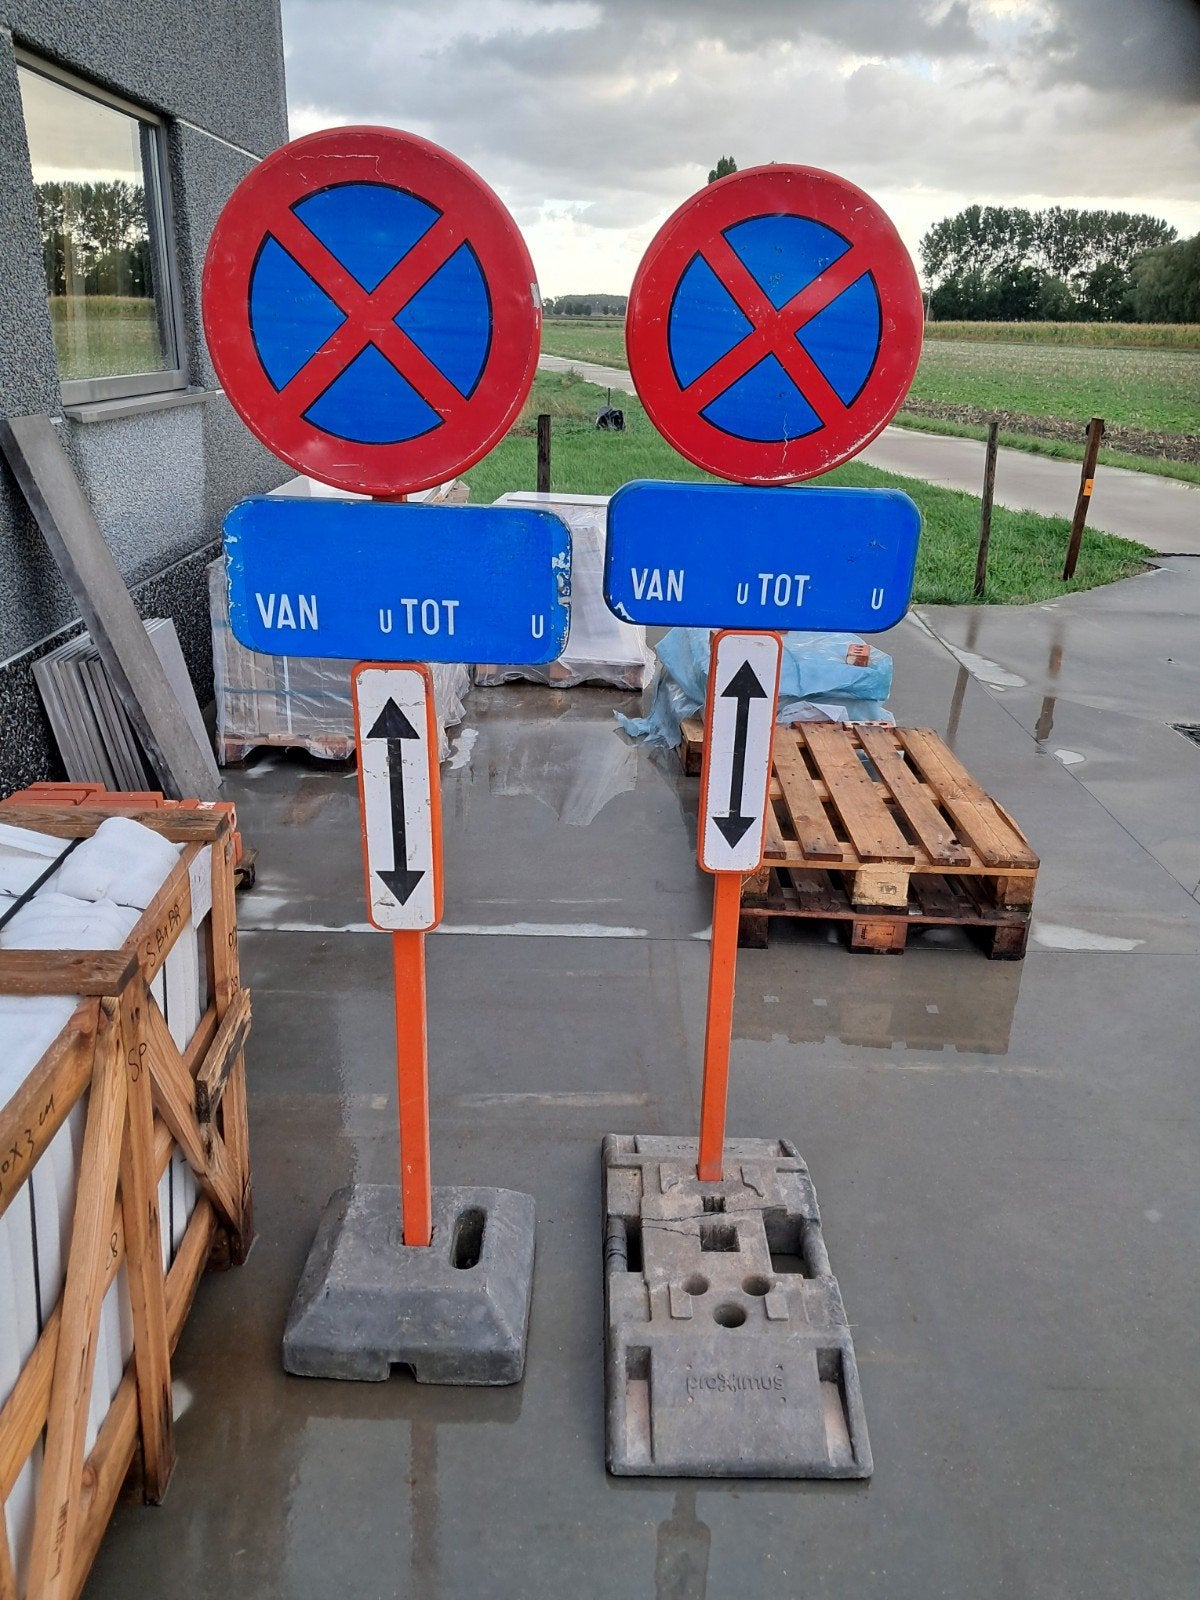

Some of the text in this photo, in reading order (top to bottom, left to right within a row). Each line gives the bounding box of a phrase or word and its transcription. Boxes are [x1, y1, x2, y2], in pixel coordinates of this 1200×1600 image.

[630, 567, 685, 602] VAN
[757, 573, 810, 607] TOT
[255, 592, 319, 630] VAN
[400, 598, 460, 636] TOT
[686, 1373, 783, 1397] proximus
